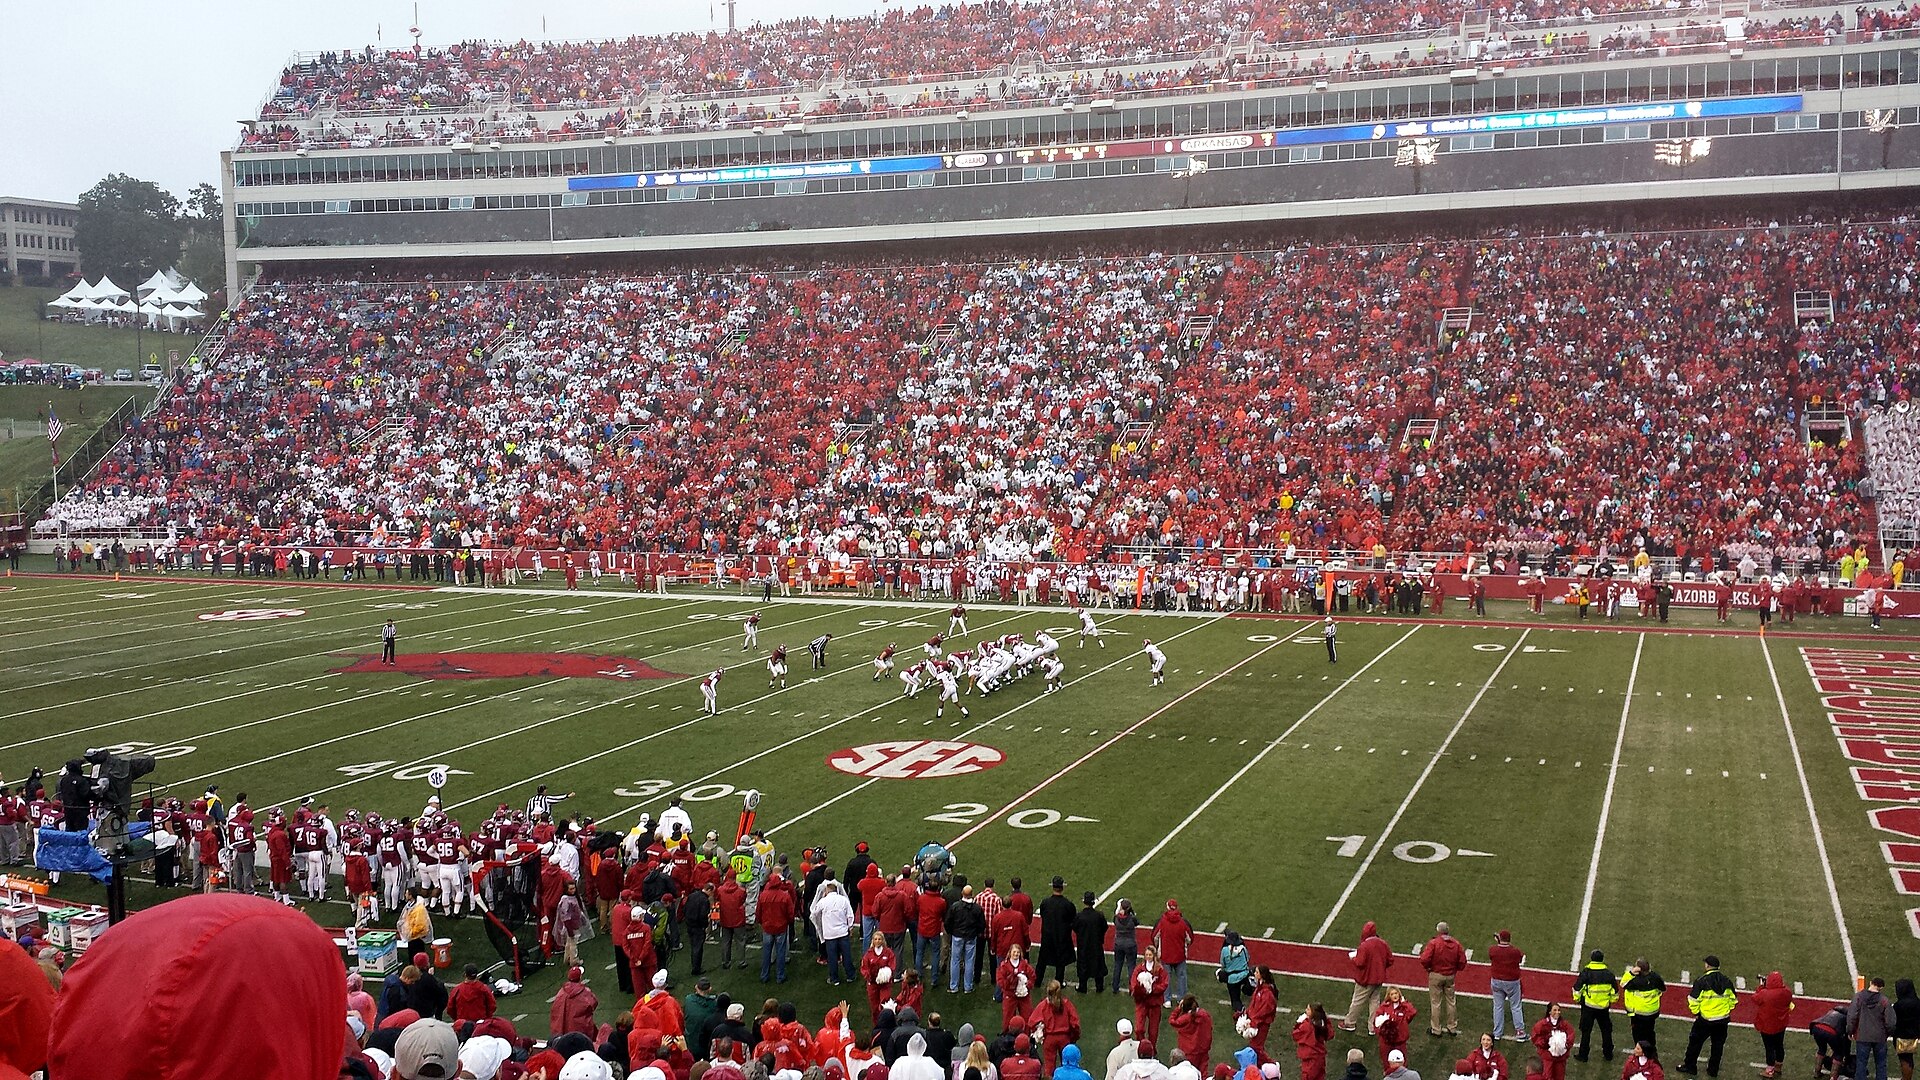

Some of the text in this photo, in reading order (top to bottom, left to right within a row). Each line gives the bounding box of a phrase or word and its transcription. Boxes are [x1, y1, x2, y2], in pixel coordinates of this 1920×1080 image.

[1186, 137, 1248, 149] ARKANSAS
[831, 740, 1001, 778] SEC
[336, 760, 450, 780] 40
[431, 772, 443, 785] SEC
[613, 779, 735, 802] 30
[31, 805, 40, 818] 16
[924, 803, 1061, 829] 20
[306, 831, 316, 845] 16
[413, 838, 427, 851] 93
[438, 842, 453, 857] 96
[471, 839, 485, 855] 97
[1326, 835, 1450, 863] 10
